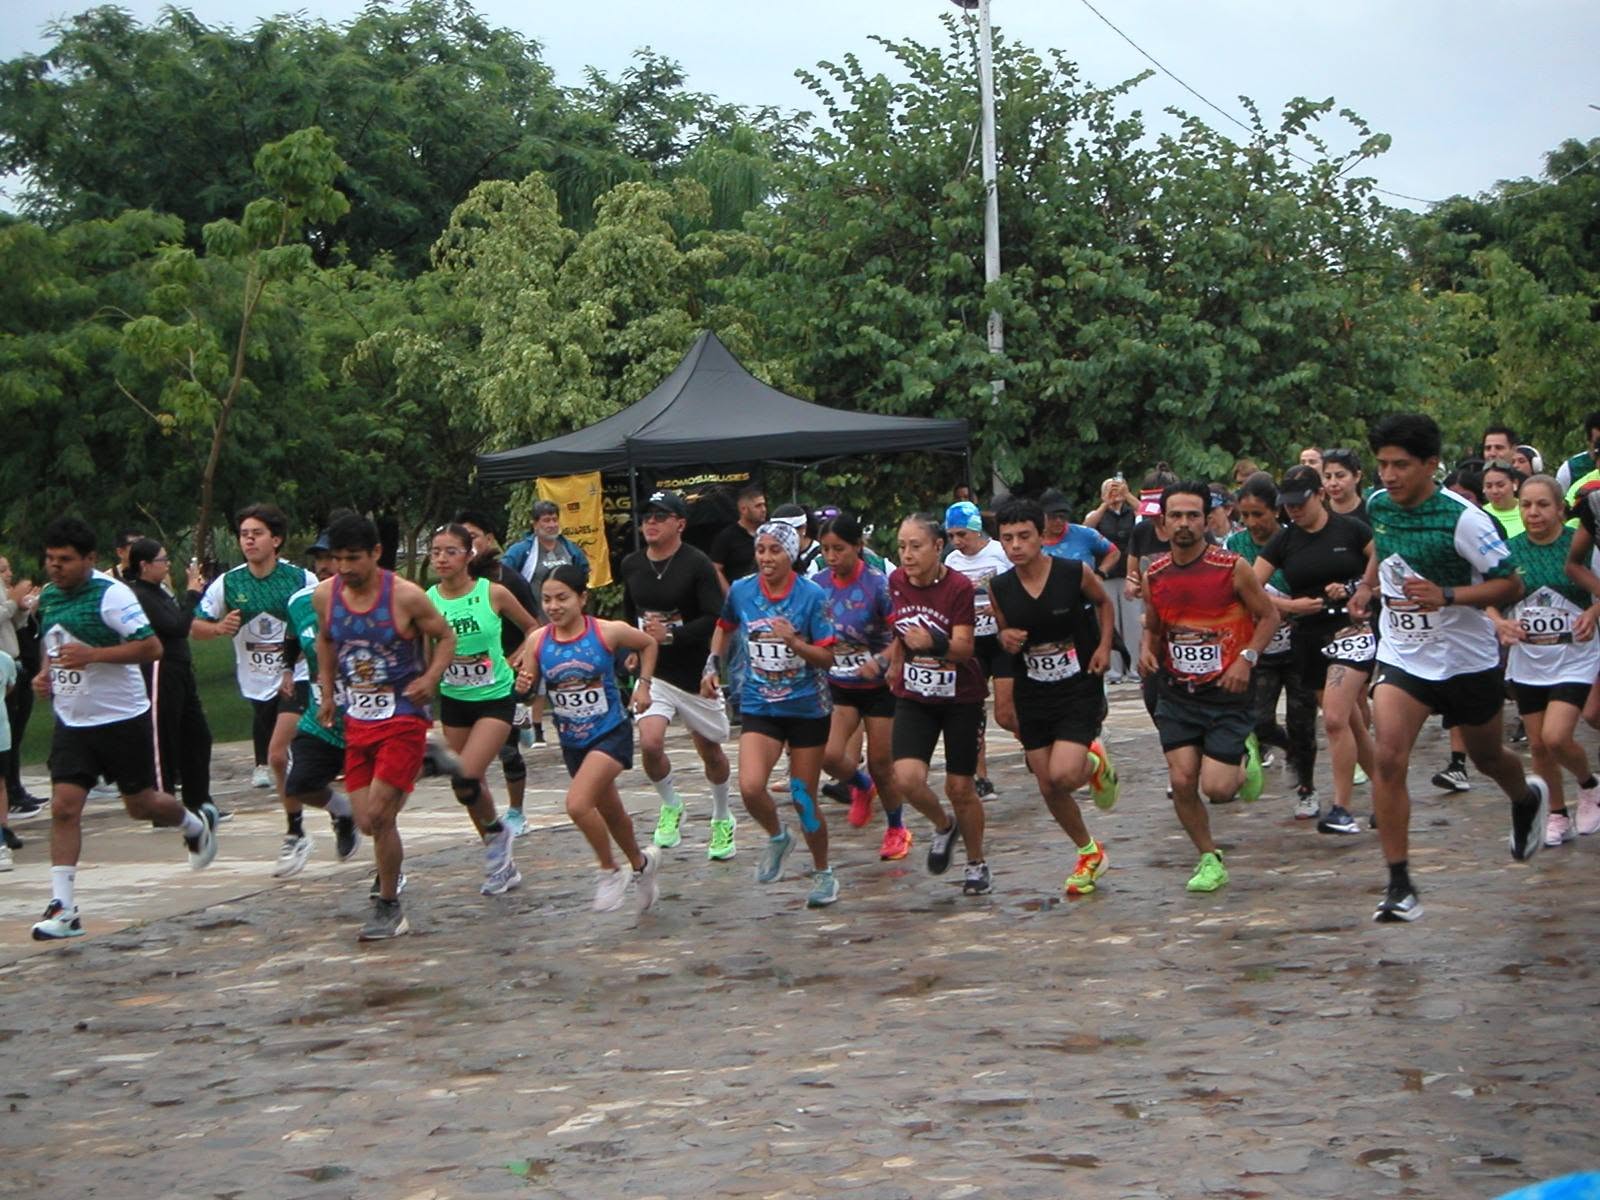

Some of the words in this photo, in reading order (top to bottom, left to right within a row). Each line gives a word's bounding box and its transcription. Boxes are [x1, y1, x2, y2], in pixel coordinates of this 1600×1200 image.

[1389, 611, 1433, 630] 081
[1172, 645, 1214, 661] 088
[1327, 636, 1369, 655] 063
[449, 664, 488, 677] 010
[1028, 654, 1071, 671] 084
[908, 667, 947, 685] 031
[555, 690, 599, 707] 030
